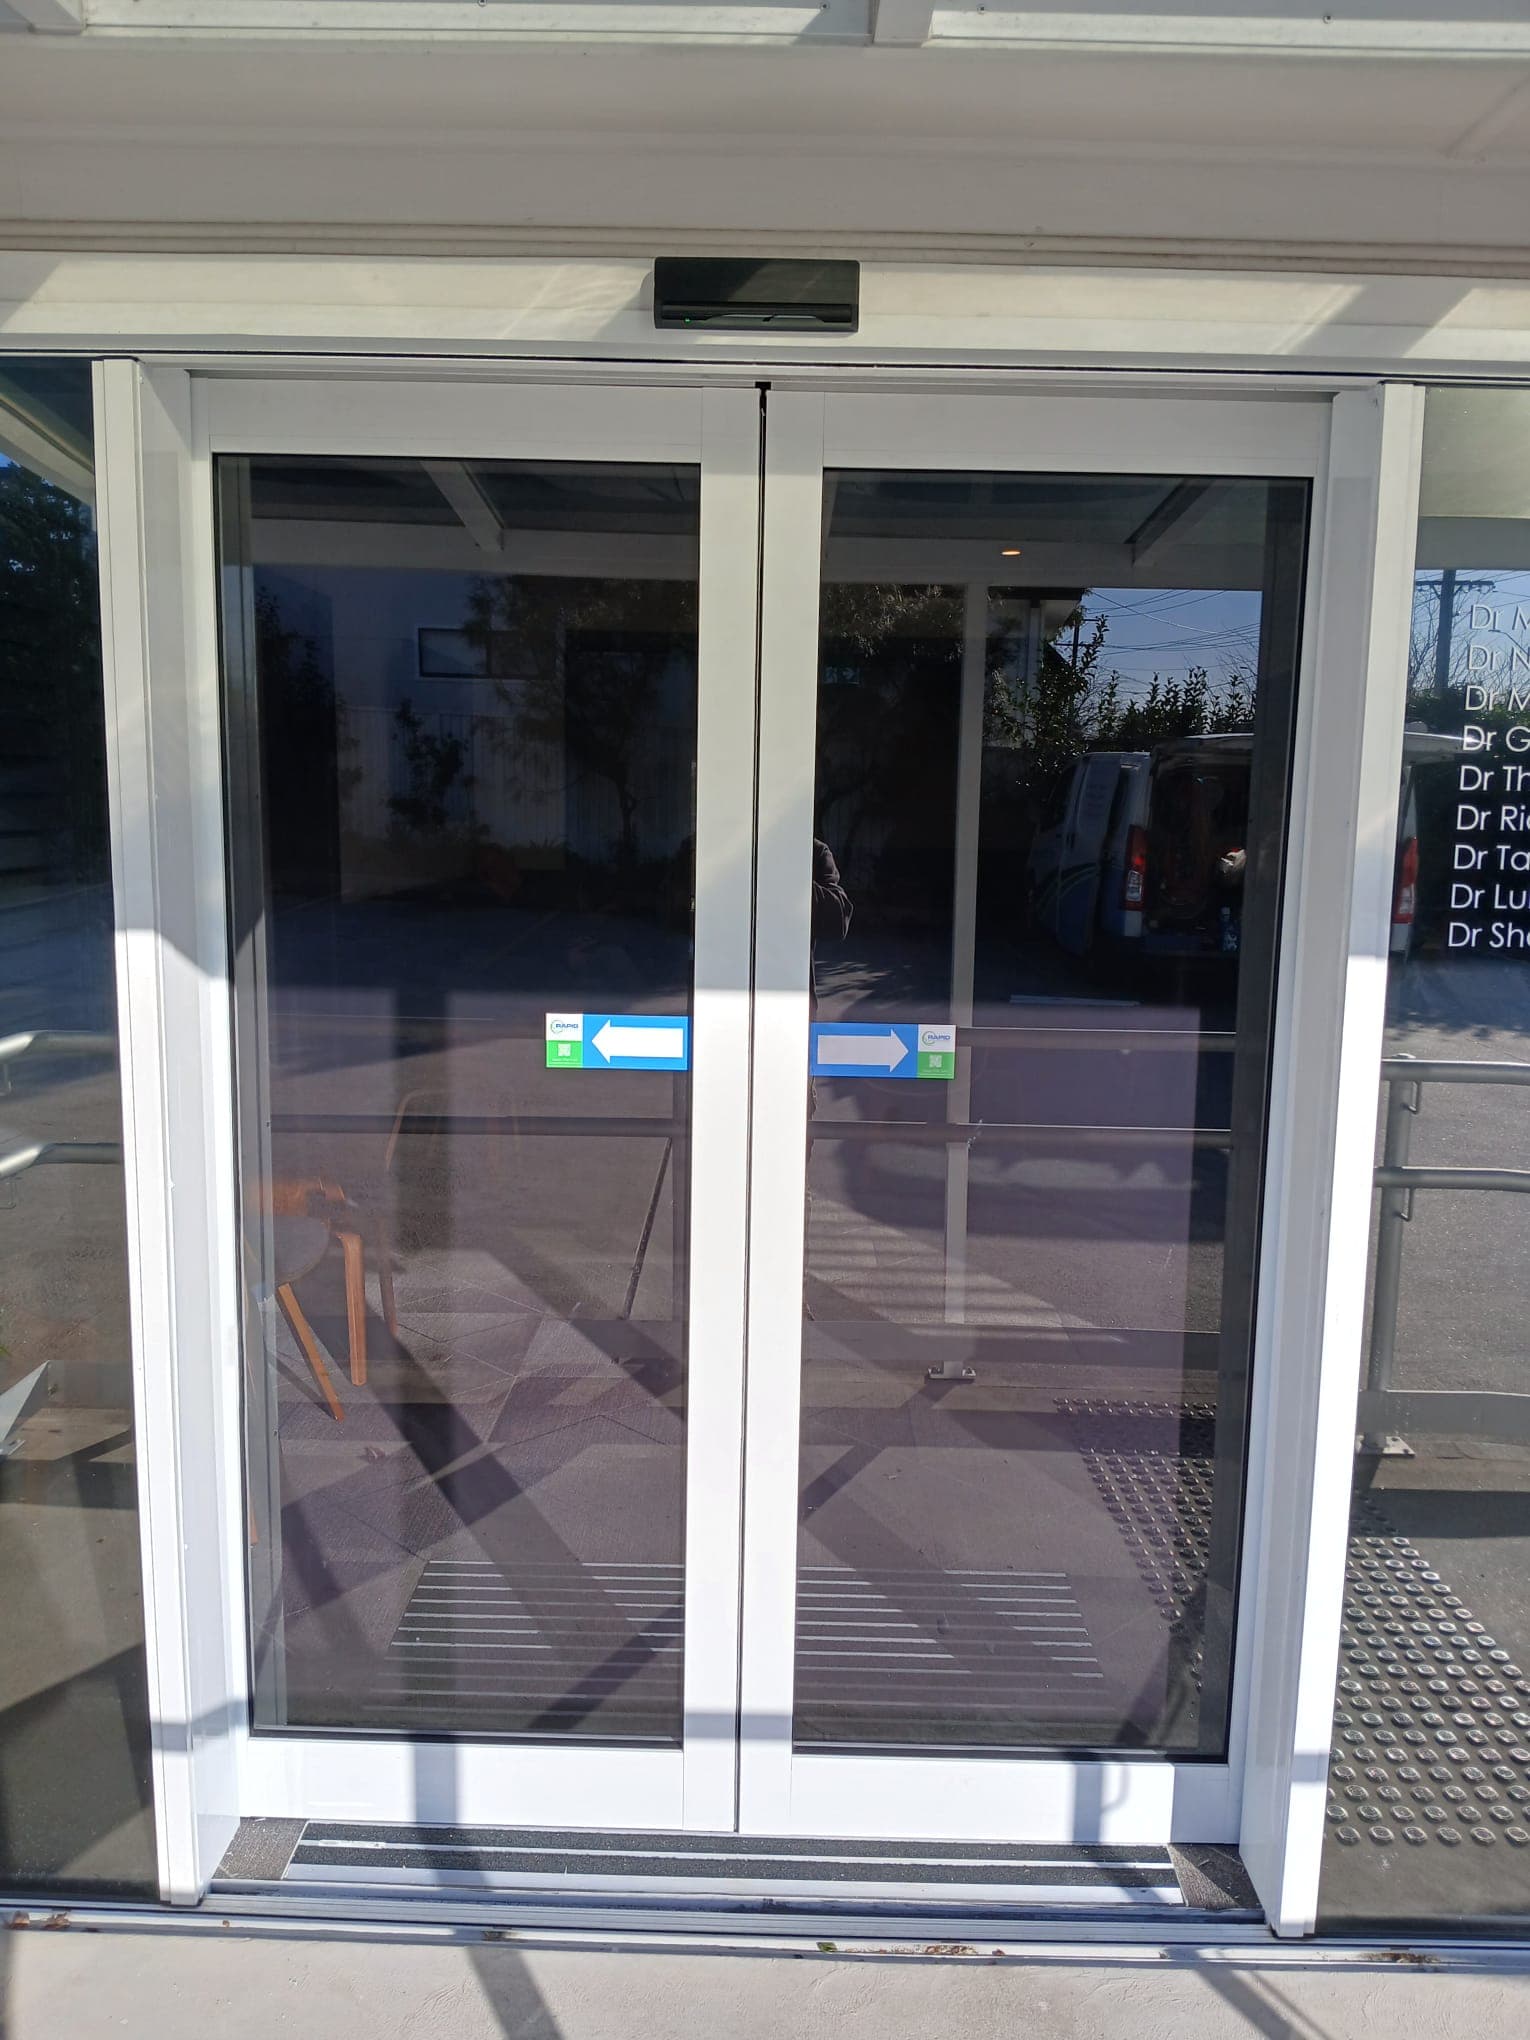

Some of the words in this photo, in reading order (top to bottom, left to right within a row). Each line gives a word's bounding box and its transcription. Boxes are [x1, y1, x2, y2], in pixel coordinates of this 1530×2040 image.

[1471, 604, 1501, 630] Dr
[1468, 645, 1500, 671] Dr
[1465, 685, 1498, 711] Dr
[1507, 687, 1530, 711] M
[1462, 725, 1497, 751] Dr
[1505, 725, 1530, 752] G
[1459, 765, 1494, 791] Dr
[1502, 765, 1530, 792] Th
[1456, 805, 1491, 831] Dr
[1500, 805, 1530, 831] Ri
[1453, 845, 1488, 870] Dr
[1496, 845, 1530, 871] Ta
[1450, 884, 1485, 909] Dr
[1494, 884, 1530, 910] Lu
[1448, 922, 1483, 948] Dr
[1489, 922, 1530, 948] Sh
